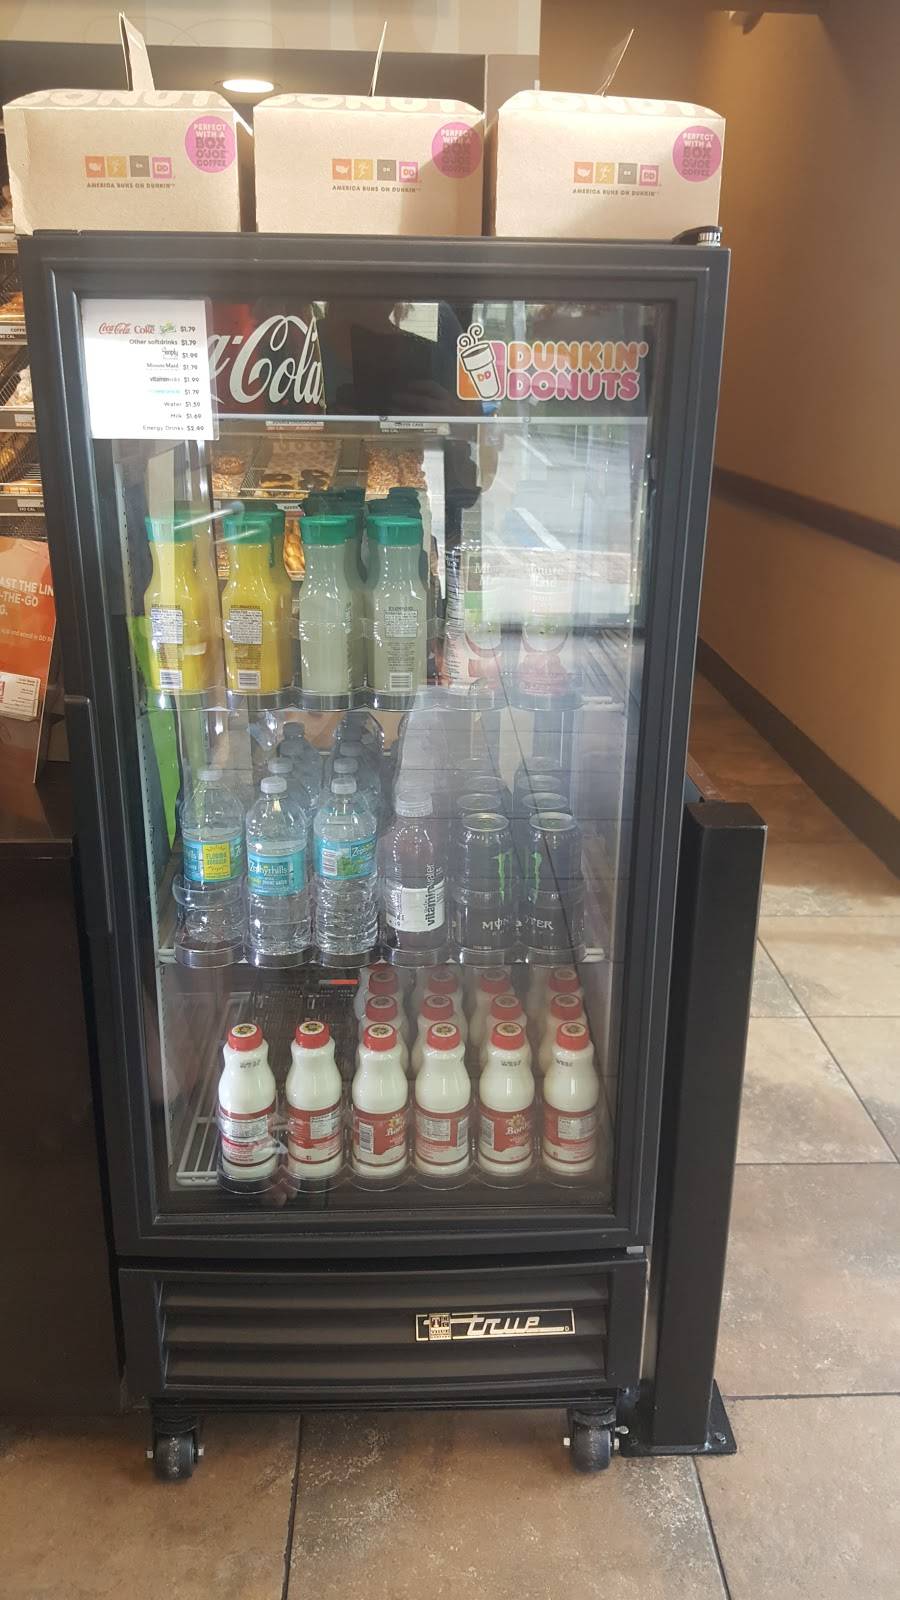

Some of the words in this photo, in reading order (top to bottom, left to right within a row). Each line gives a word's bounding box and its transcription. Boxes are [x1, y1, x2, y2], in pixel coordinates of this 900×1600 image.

[195, 137, 226, 149] BOX
[507, 341, 649, 372] DUNKIN'
[476, 370, 492, 383] DD
[507, 371, 641, 401] DONUTS
[19, 579, 38, 593] THE
[38, 583, 54, 597] LIN
[0, 590, 39, 607] -THE-GO
